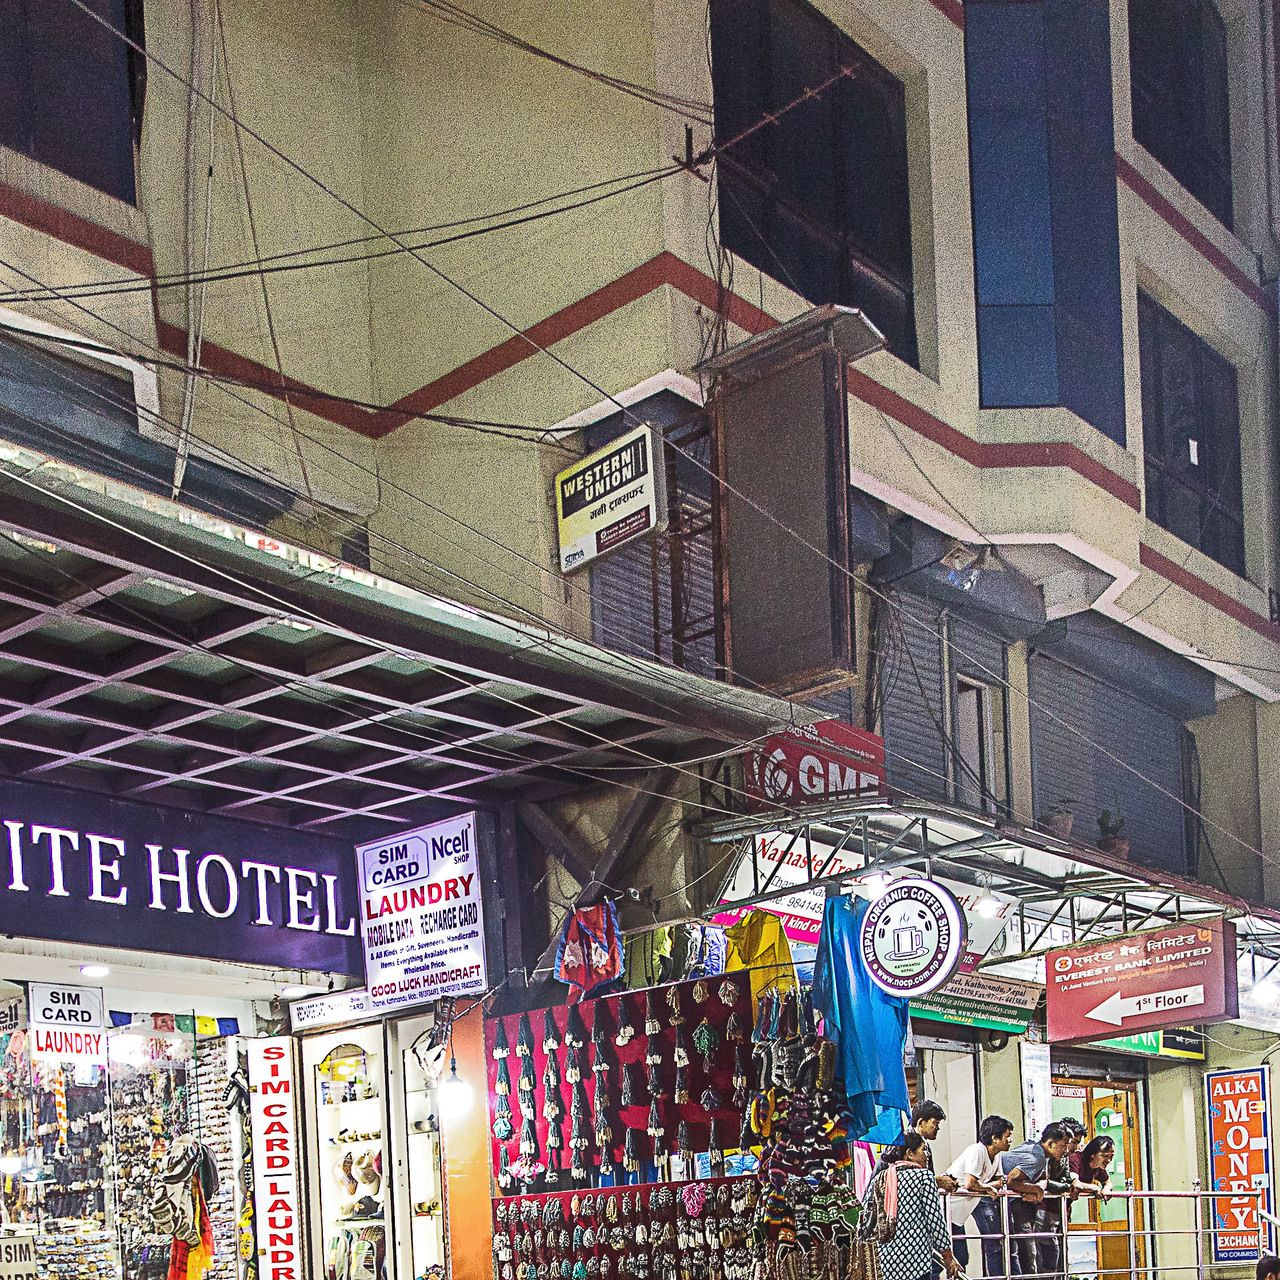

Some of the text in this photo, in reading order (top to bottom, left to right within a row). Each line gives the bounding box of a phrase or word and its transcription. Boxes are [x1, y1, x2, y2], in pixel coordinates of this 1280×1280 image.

[564, 448, 632, 498] WESTERN
[585, 464, 632, 501] UNION
[378, 828, 470, 865] SIM Ncell
[453, 853, 470, 865] SHOP
[372, 862, 420, 886] CARD
[145, 842, 357, 938] HOTEL
[365, 872, 475, 921] LAUNDRY
[367, 902, 478, 948] MOBILE DATA RECHARGE CARD
[787, 914, 808, 931] kind
[864, 888, 949, 963] NEPAL ORGANIC COFFEE SHOP
[1010, 919, 1058, 942] HOTEL
[877, 960, 939, 987] www.nocp.com.np
[1055, 946, 1213, 984] EVEREST BANK LIMITED
[371, 981, 397, 998] GOOD
[398, 975, 421, 993] LUCK
[422, 964, 481, 988] HANDICRAFT
[49, 991, 81, 1006] SIM
[1155, 993, 1189, 1008] Floor
[42, 1007, 93, 1023] CARD
[943, 1014, 974, 1025] INSIDE
[36, 1031, 102, 1056] LAUNDRY
[261, 1046, 291, 1095] SIM
[1213, 1078, 1259, 1097] ALKA
[1223, 1097, 1252, 1231] MONEY
[4, 1243, 32, 1264] SIM
